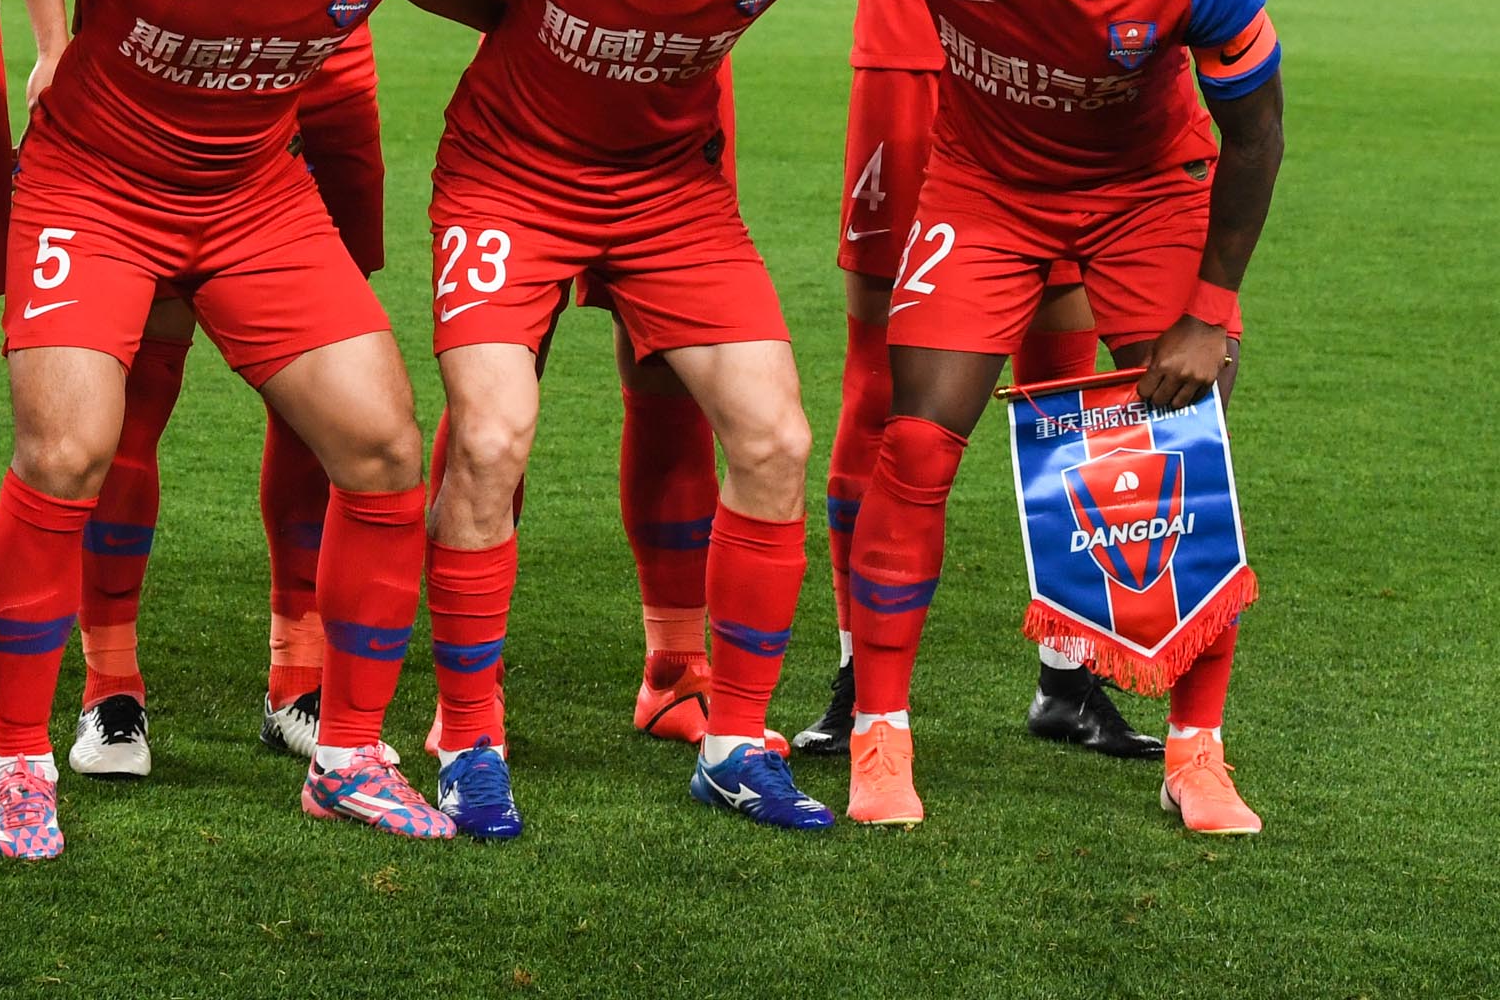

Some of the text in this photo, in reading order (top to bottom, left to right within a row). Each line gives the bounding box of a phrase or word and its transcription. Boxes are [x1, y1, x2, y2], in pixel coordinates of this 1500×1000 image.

[118, 39, 313, 92] SWM MOTOR
[537, 29, 716, 84] SWM MOTOR
[947, 54, 998, 97] WM
[851, 140, 887, 212] 4
[33, 227, 77, 290] 5
[436, 225, 512, 300] 23
[1070, 512, 1195, 553] DANGDAI
